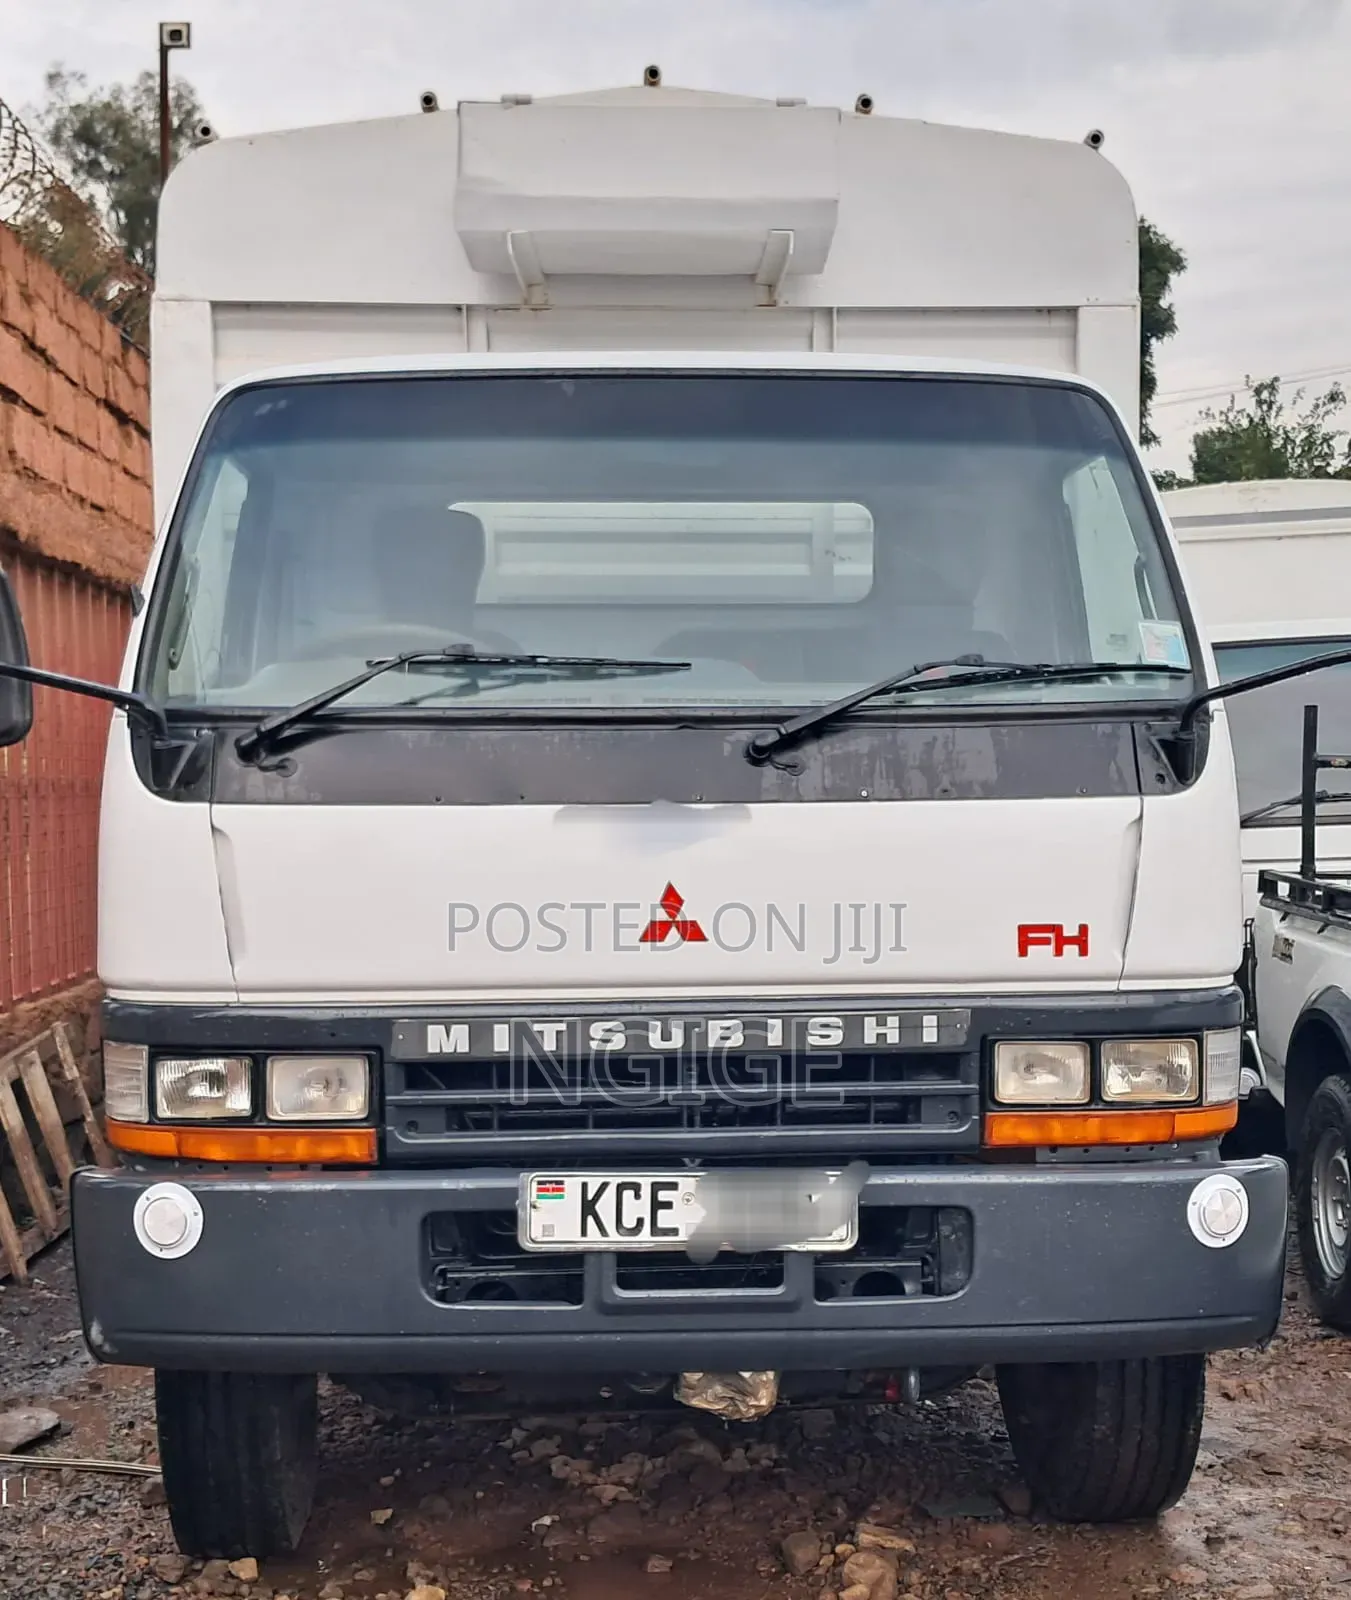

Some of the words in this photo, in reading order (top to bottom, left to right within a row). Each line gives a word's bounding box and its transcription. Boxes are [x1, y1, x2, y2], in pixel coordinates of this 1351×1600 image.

[1017, 923, 1089, 957] FH
[426, 1015, 939, 1053] MITSUBISHI
[580, 1181, 680, 1238] KCE
